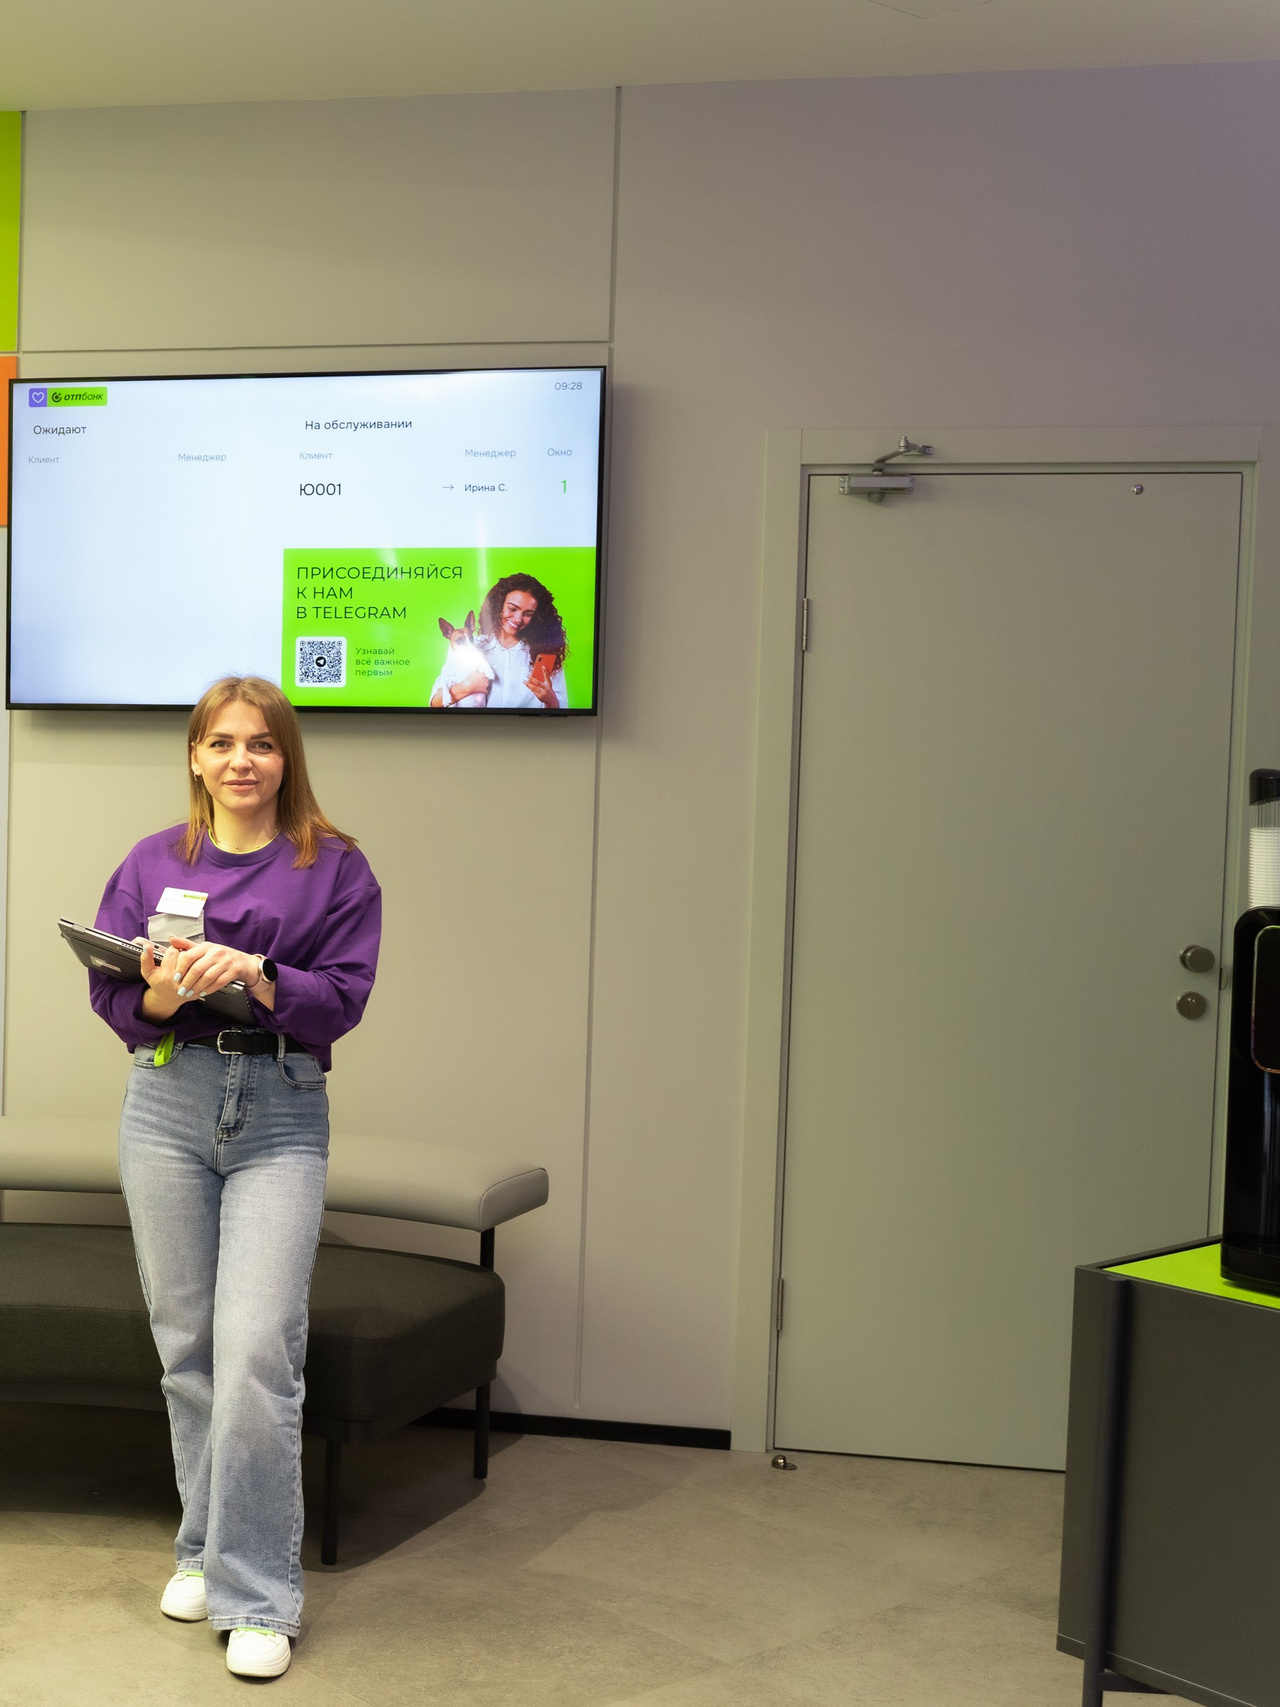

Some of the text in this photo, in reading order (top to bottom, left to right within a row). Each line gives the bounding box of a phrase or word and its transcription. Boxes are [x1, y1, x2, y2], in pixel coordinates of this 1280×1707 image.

[554, 381, 583, 391] 09:28
[64, 391, 104, 402] отпбанк
[33, 424, 87, 436] Ожидают
[305, 418, 413, 432] На обслуживании
[299, 451, 333, 460] Клиент
[464, 448, 517, 459] Менеджер
[547, 447, 573, 457] Окно
[28, 455, 60, 464] Клиент
[178, 453, 227, 464] Менеджер
[299, 483, 342, 496] Ю001
[464, 483, 496, 493] Ирина
[560, 479, 568, 494] 1
[296, 563, 463, 582] ПРИСОЕДИНЯЙСЯ
[296, 586, 353, 600] К НАМ
[296, 605, 407, 619] В TELEGRAM
[355, 647, 395, 655] Узнавай
[355, 669, 393, 677] первым
